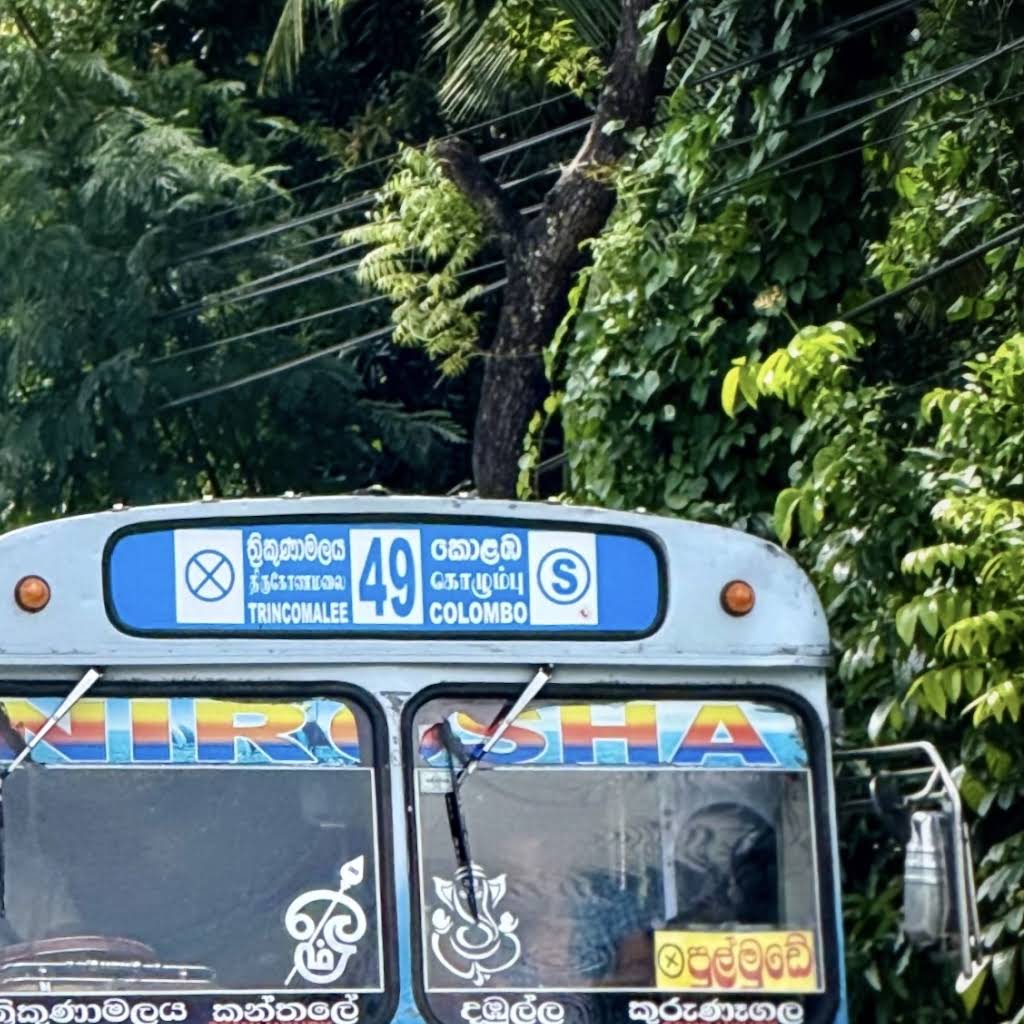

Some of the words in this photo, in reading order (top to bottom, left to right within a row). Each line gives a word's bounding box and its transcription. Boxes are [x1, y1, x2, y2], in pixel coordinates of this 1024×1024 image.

[430, 533, 522, 565] කොළඹ
[359, 536, 416, 617] 49
[430, 565, 524, 599] கொழும்பு
[552, 558, 579, 595] S
[247, 602, 349, 624] TRINCOMALEE
[429, 602, 528, 624] COLOMBO
[212, 993, 360, 1024] කන්තලේ
